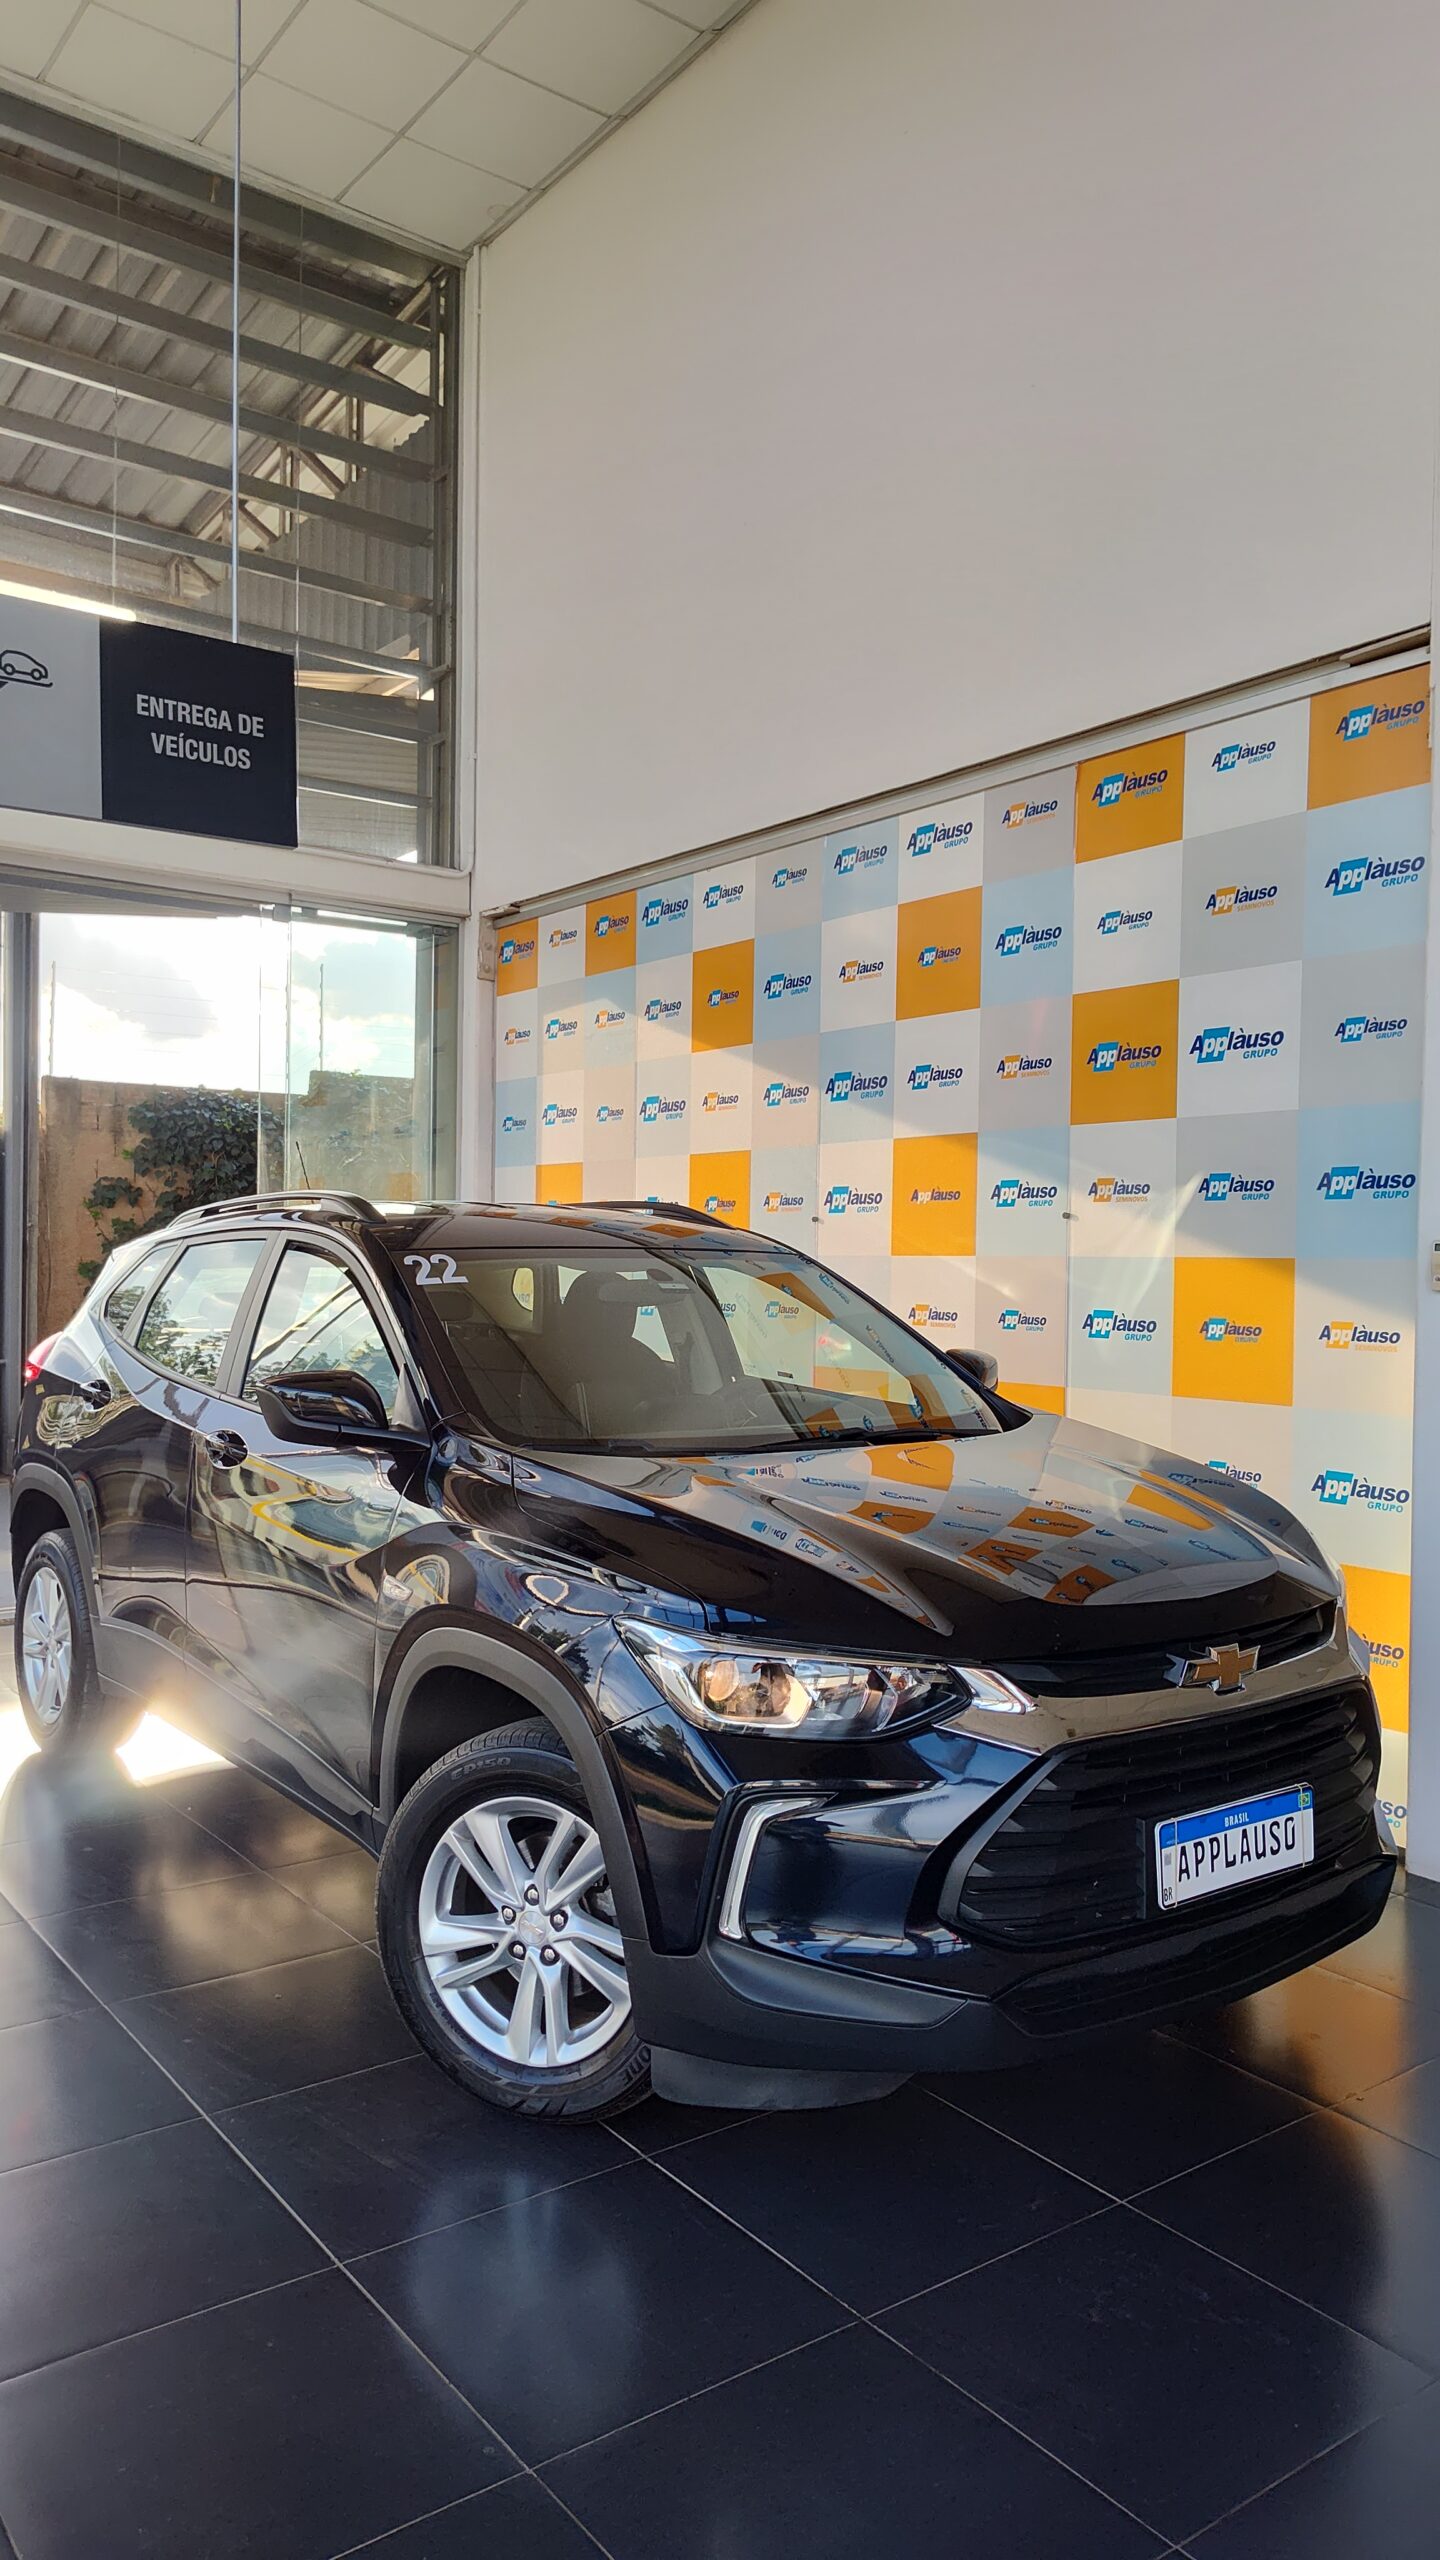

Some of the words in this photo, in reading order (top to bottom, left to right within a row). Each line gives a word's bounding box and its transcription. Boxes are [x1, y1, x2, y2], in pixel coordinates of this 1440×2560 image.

[136, 694, 232, 732] ENTREGA
[238, 714, 264, 738] DE
[1335, 699, 1425, 741] Applàuso
[1386, 715, 1420, 731] GRUPO
[151, 732, 251, 770] VEÍCULOS
[1211, 740, 1276, 772] Applàuso
[1247, 752, 1272, 764] GRUPO
[1092, 768, 1168, 807] Applàuso
[1134, 785, 1163, 798] GRUPO
[907, 821, 973, 857] Applàuso
[944, 836, 969, 849] GRUPO
[1324, 856, 1426, 896] Applàuso
[1381, 873, 1418, 888] GRUPO
[1205, 884, 1278, 916] Applàuso
[1236, 899, 1275, 912] SEMINOVOS
[995, 925, 1062, 956] Applàuso
[1033, 940, 1058, 951] GRUPO
[1334, 1016, 1408, 1043] Applàuso
[1376, 1030, 1404, 1040] GRUPO
[1087, 1041, 1162, 1072] Applàuso
[1189, 1027, 1285, 1064] Applàuso
[1242, 1048, 1278, 1060] GRUPO
[1129, 1059, 1157, 1069] GRUPO
[825, 1072, 888, 1102] Applàuso
[860, 1090, 884, 1099] GRUPO
[990, 1180, 1057, 1207] Applàuso
[1088, 1178, 1150, 1203] Applàuso
[1198, 1173, 1275, 1201] Applàuso
[1241, 1193, 1270, 1201] GRUPO
[1316, 1167, 1416, 1200] Applàuso
[1372, 1189, 1409, 1200] GRUPO
[1028, 1199, 1054, 1207] GRUPO
[1115, 1195, 1148, 1203] SEMINOVOS
[404, 1254, 469, 1286] 22
[1082, 1310, 1157, 1339] Applàuso
[1123, 1332, 1152, 1342] GRUPO
[1318, 1322, 1401, 1349] Applàuso
[1311, 1471, 1410, 1506] Applàuso
[1367, 1501, 1404, 1513] GRUPO
[1224, 1812, 1249, 1827] BRASIL
[1178, 1817, 1296, 1882] APPLAUSO
[1163, 1887, 1173, 1902] BR
